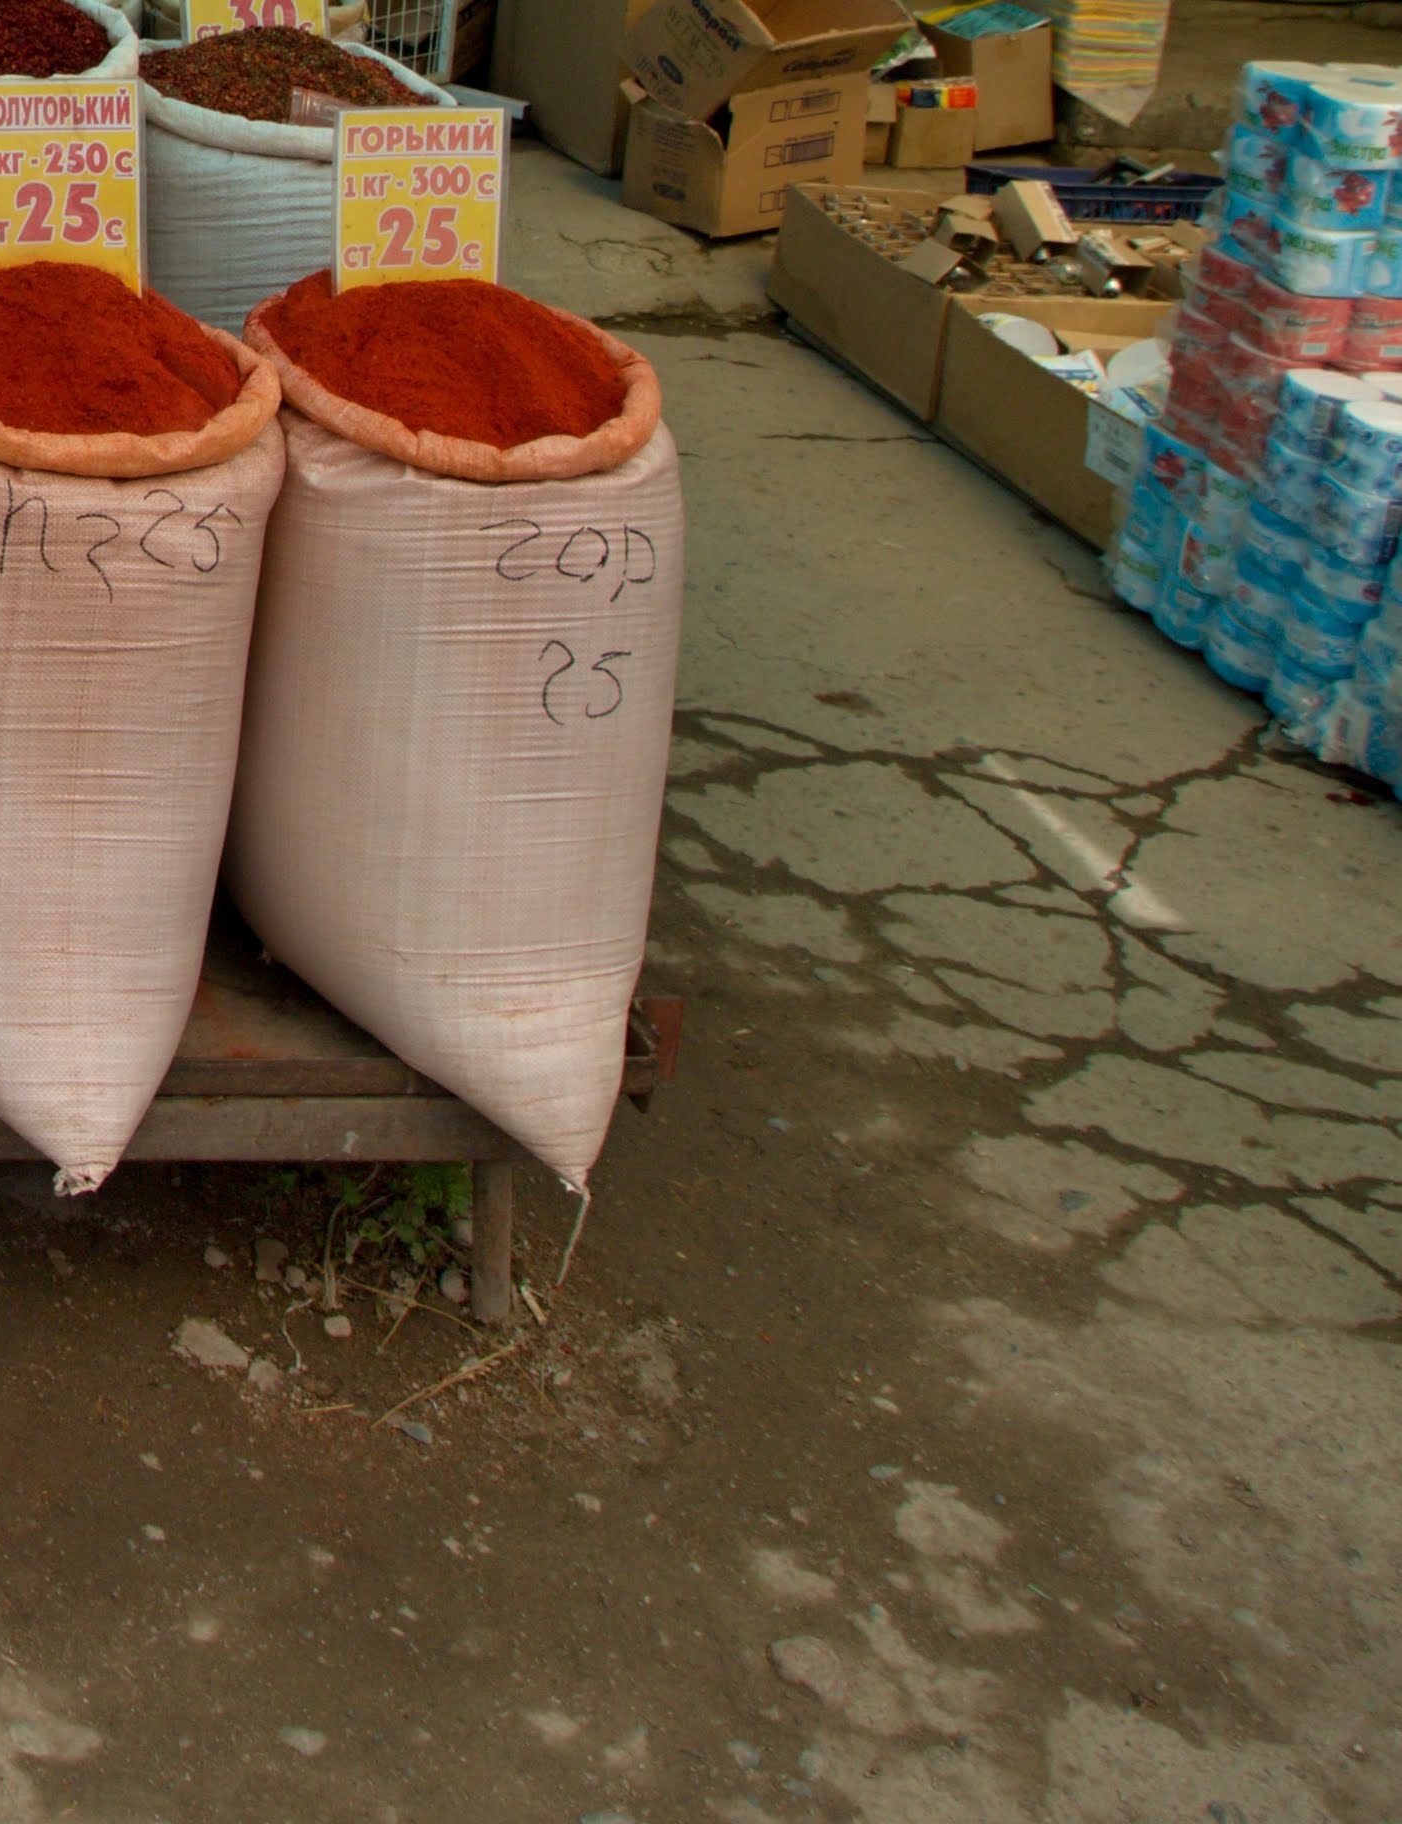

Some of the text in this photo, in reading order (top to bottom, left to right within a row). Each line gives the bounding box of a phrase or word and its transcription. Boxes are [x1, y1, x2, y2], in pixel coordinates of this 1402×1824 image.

[348, 118, 494, 153] ГОРЬКИЙ
[45, 143, 107, 173] 250
[345, 177, 355, 197] 1
[412, 166, 470, 195] 300
[17, 183, 99, 242] 25
[379, 208, 457, 265] 25
